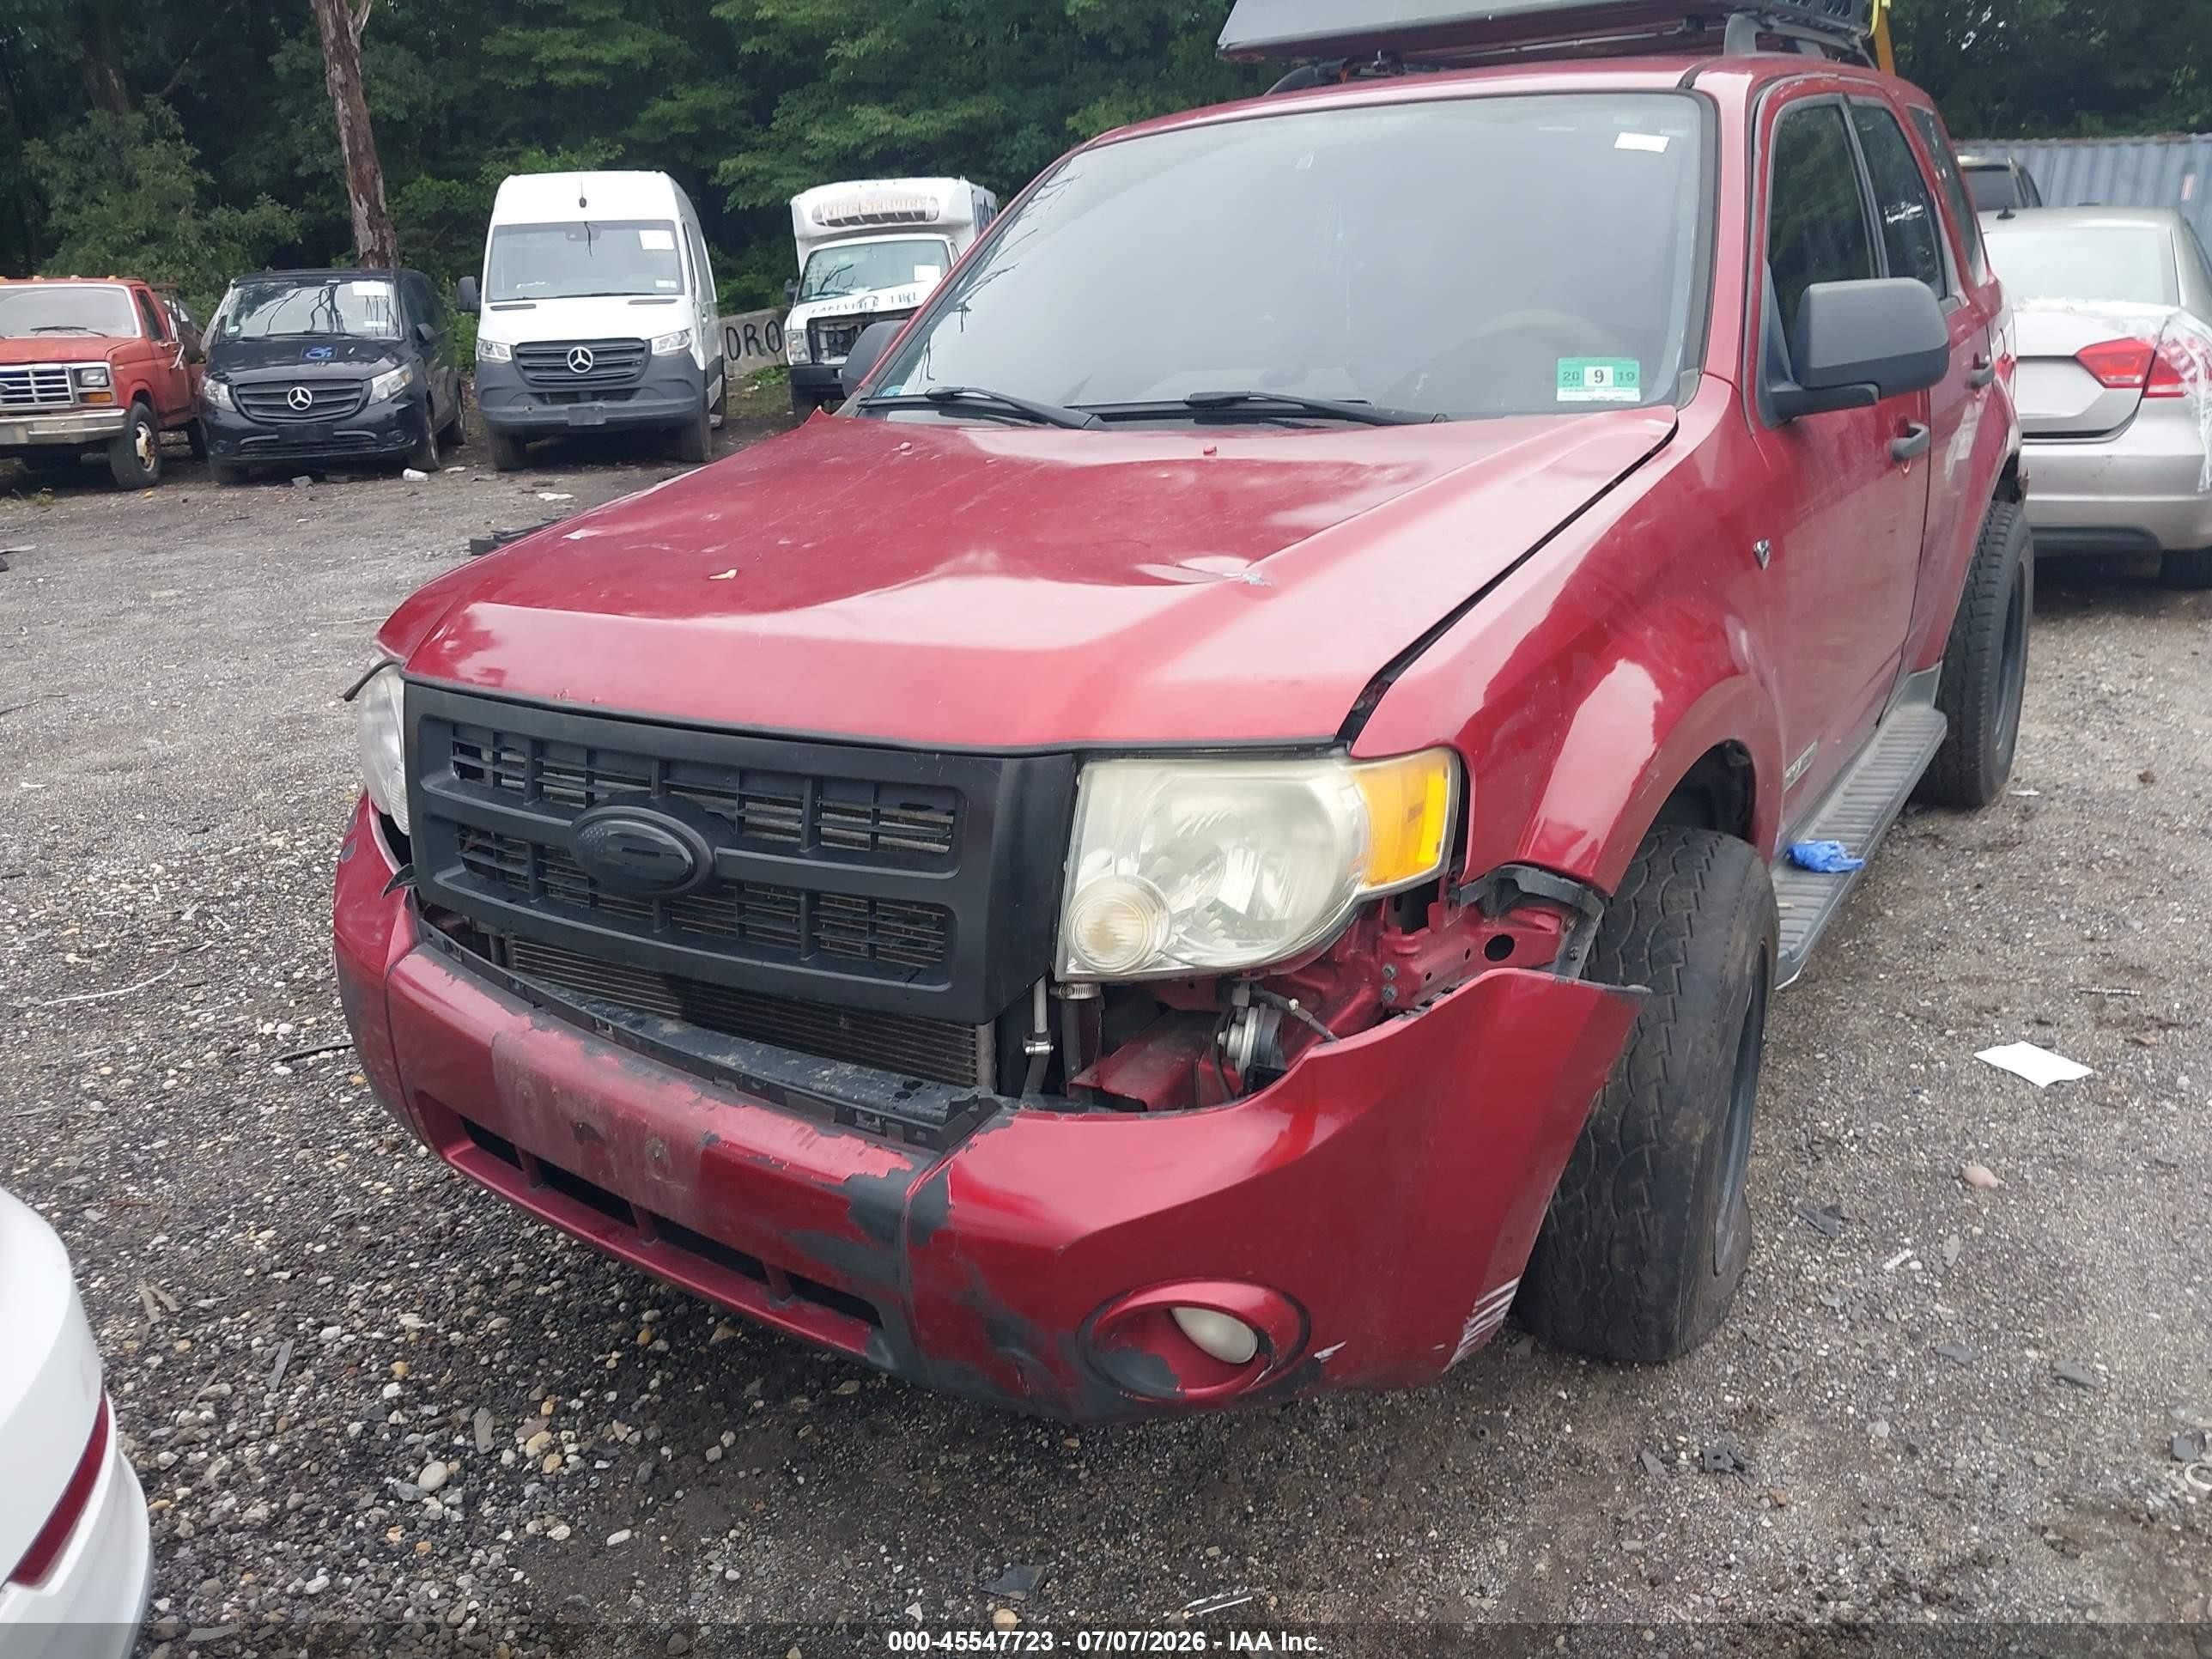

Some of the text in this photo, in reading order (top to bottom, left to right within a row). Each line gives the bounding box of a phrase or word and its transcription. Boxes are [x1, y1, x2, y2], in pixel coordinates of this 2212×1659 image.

[1563, 370, 1636, 384] 20 9 19
